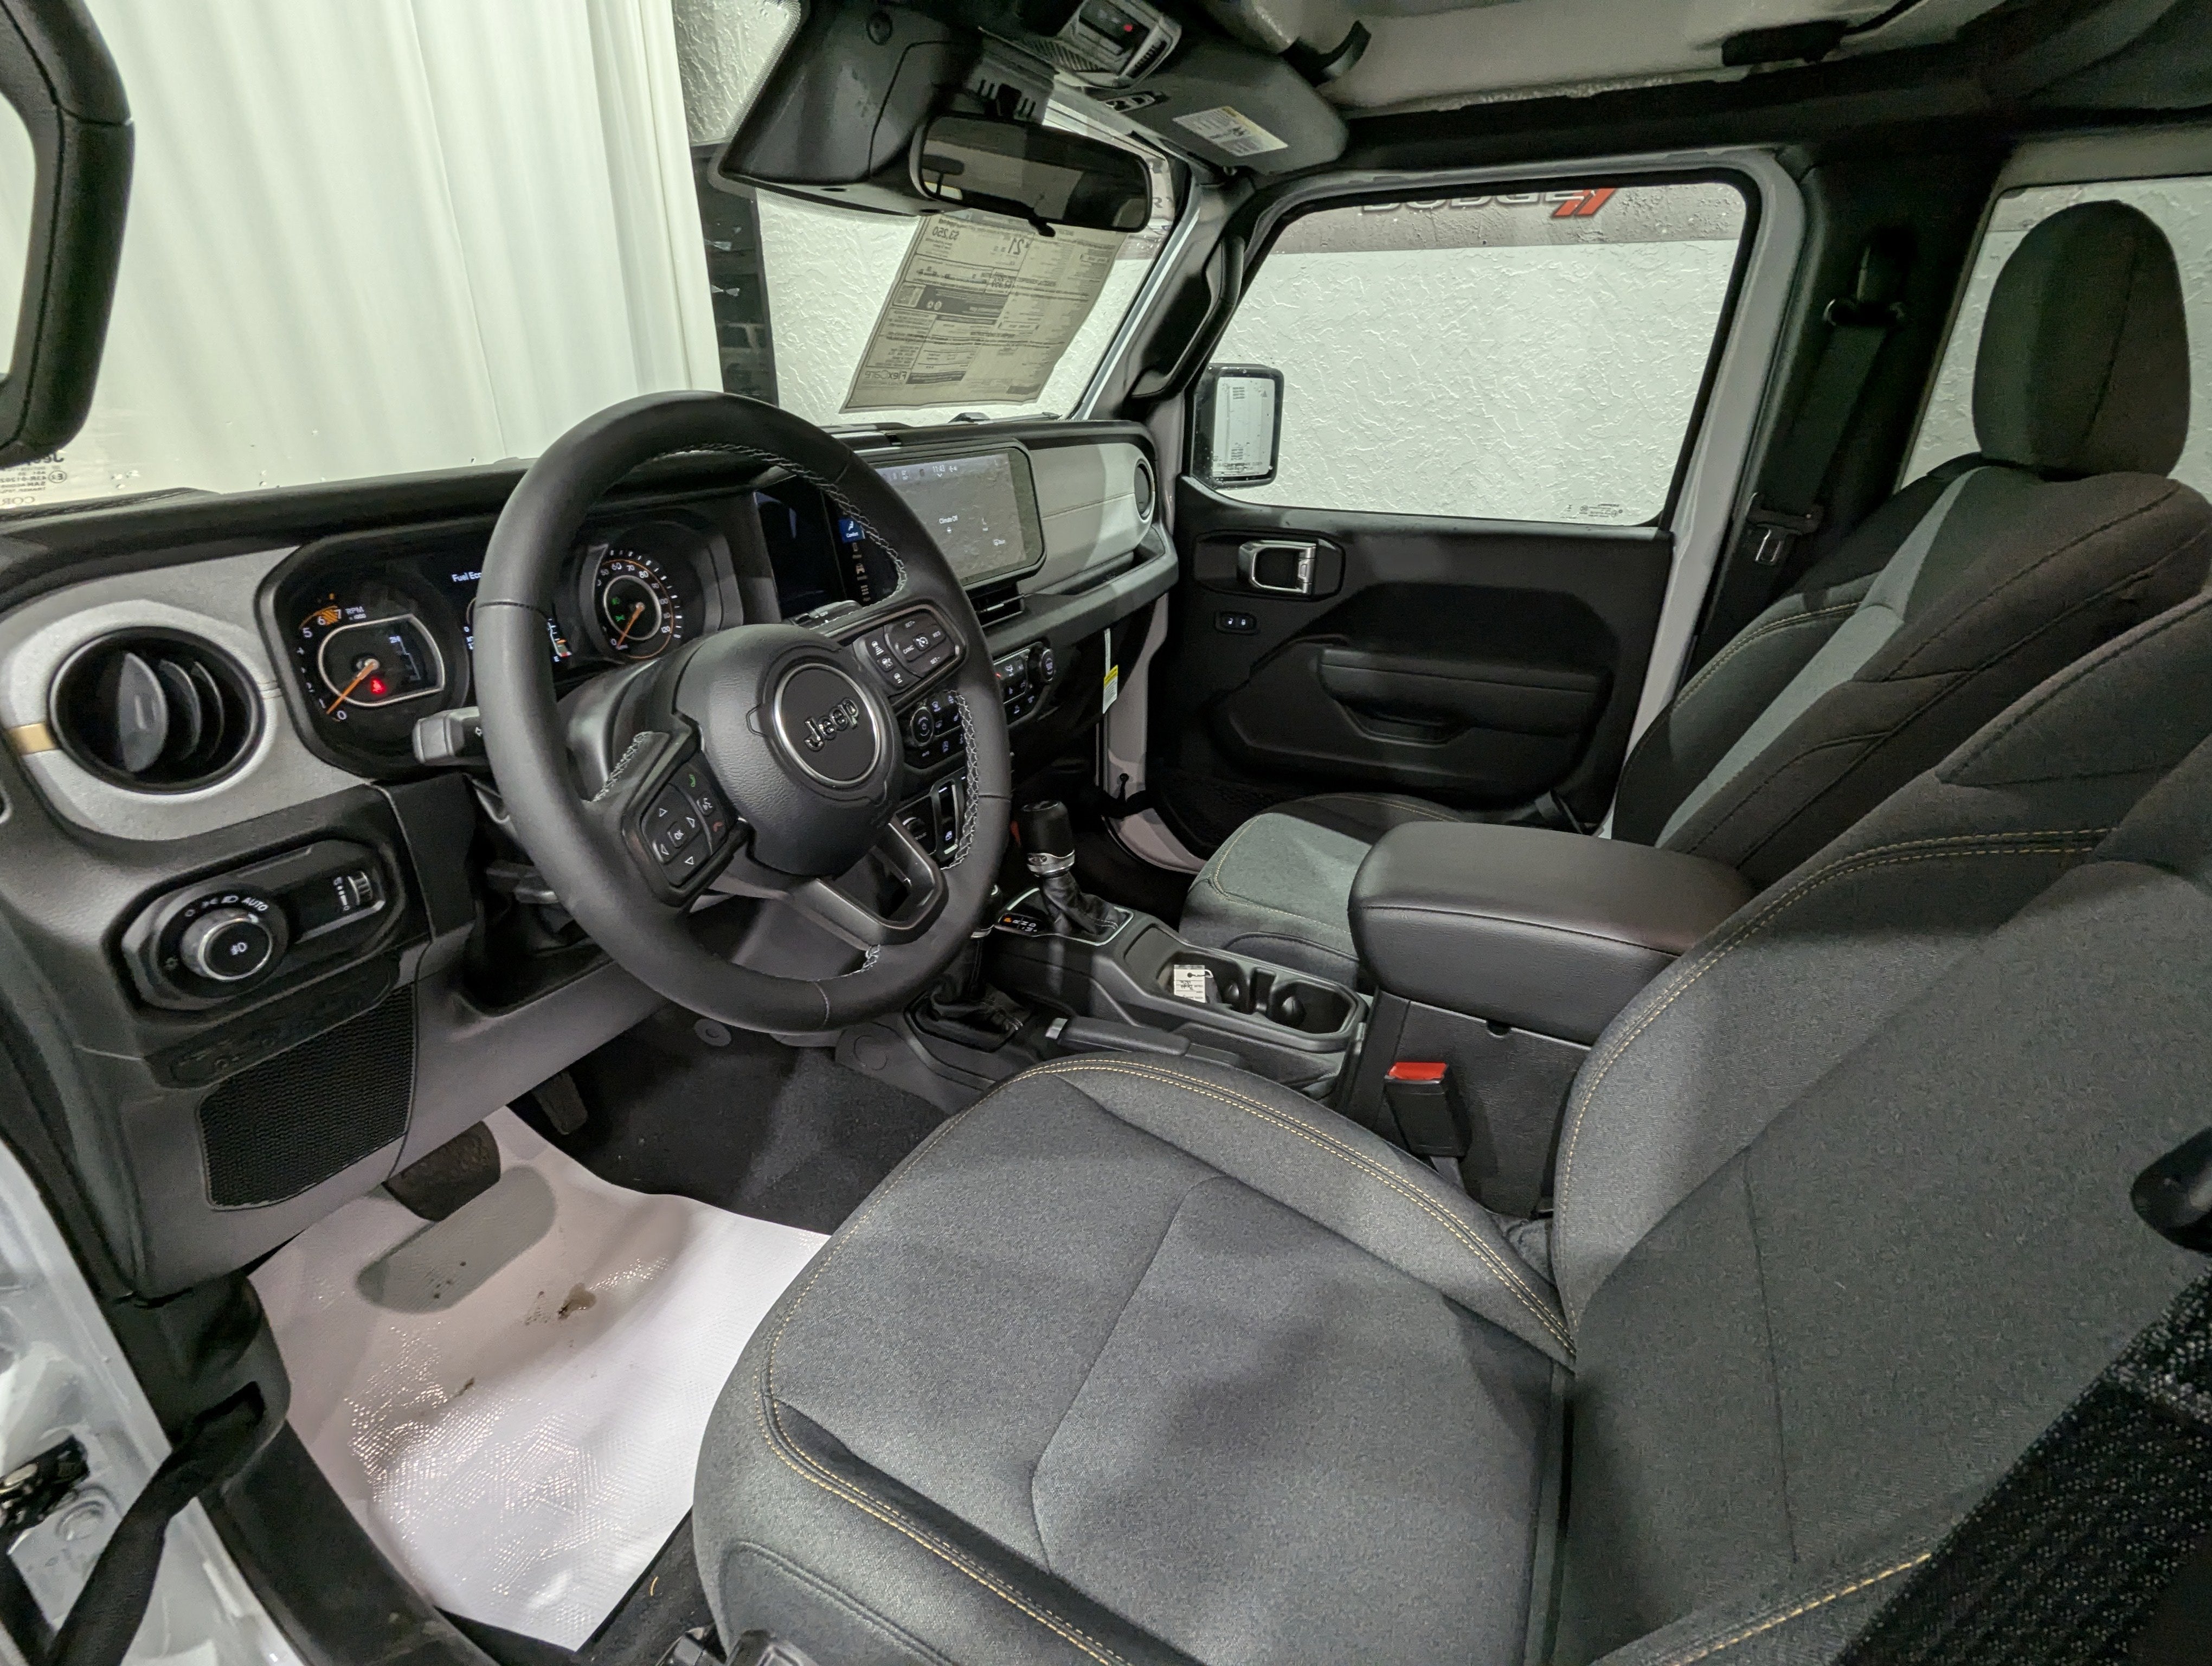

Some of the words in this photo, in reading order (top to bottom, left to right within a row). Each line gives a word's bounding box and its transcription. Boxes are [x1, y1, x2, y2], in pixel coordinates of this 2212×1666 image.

[451, 572, 468, 582] Fuel
[317, 615, 326, 626] 6
[302, 626, 313, 638] 5
[336, 709, 348, 721] 0
[804, 697, 860, 752] Jeep
[673, 829, 685, 841] OK
[241, 896, 269, 912] AUTO
